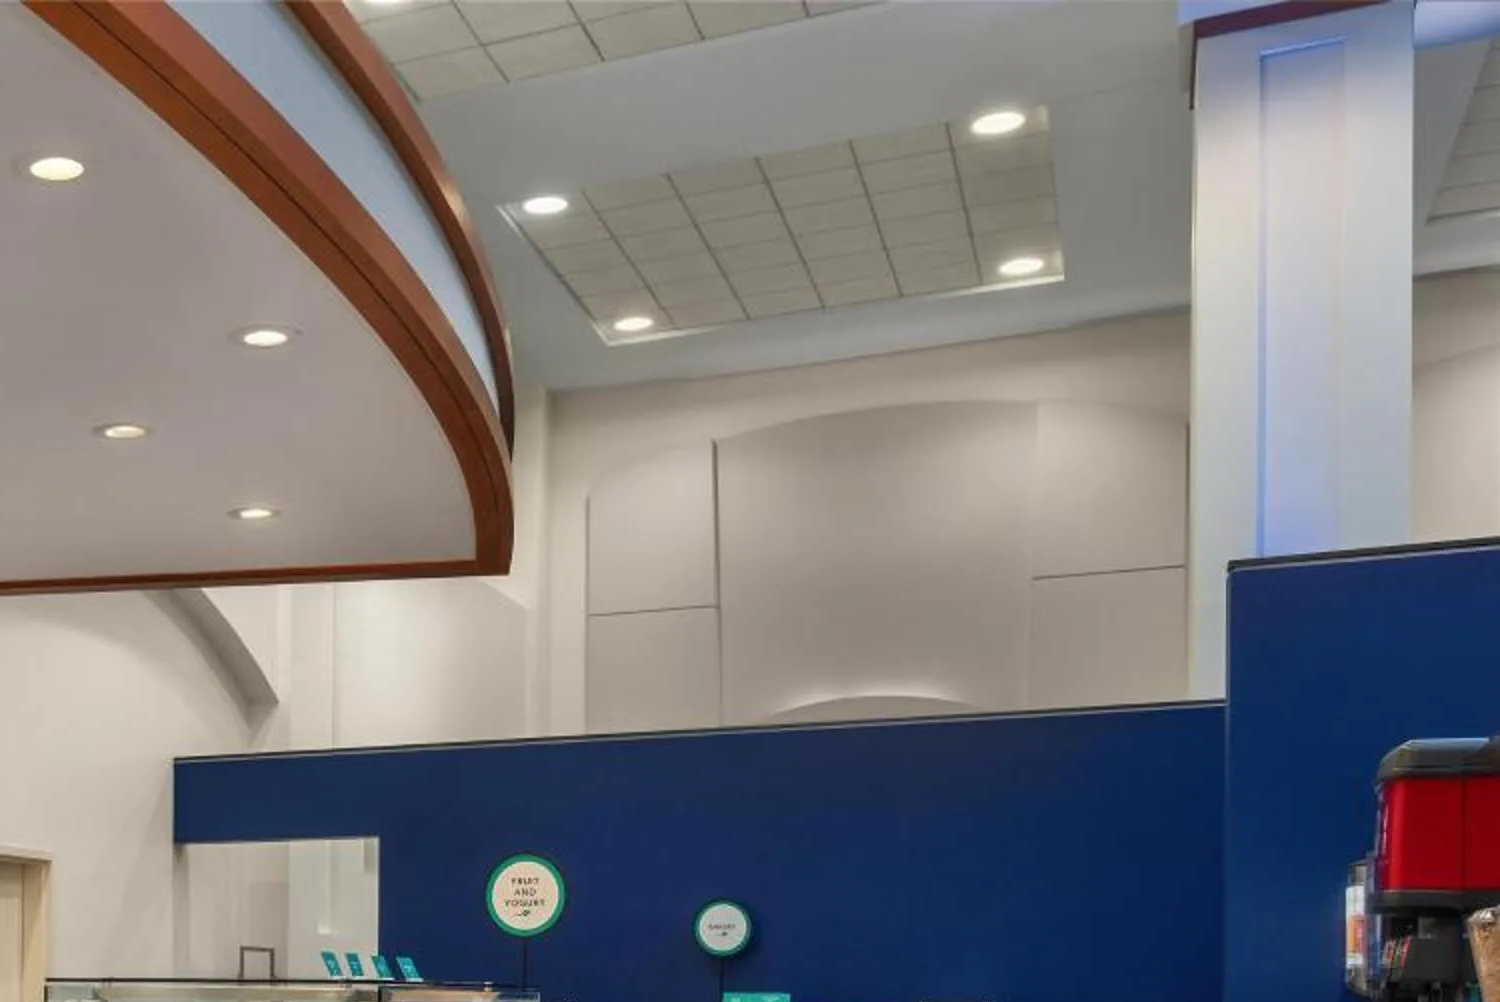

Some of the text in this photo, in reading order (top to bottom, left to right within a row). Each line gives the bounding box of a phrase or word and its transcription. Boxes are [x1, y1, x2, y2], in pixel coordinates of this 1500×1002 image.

[511, 877, 540, 885] FRUIT
[513, 888, 537, 897] AND
[504, 899, 545, 907] YOGURT
